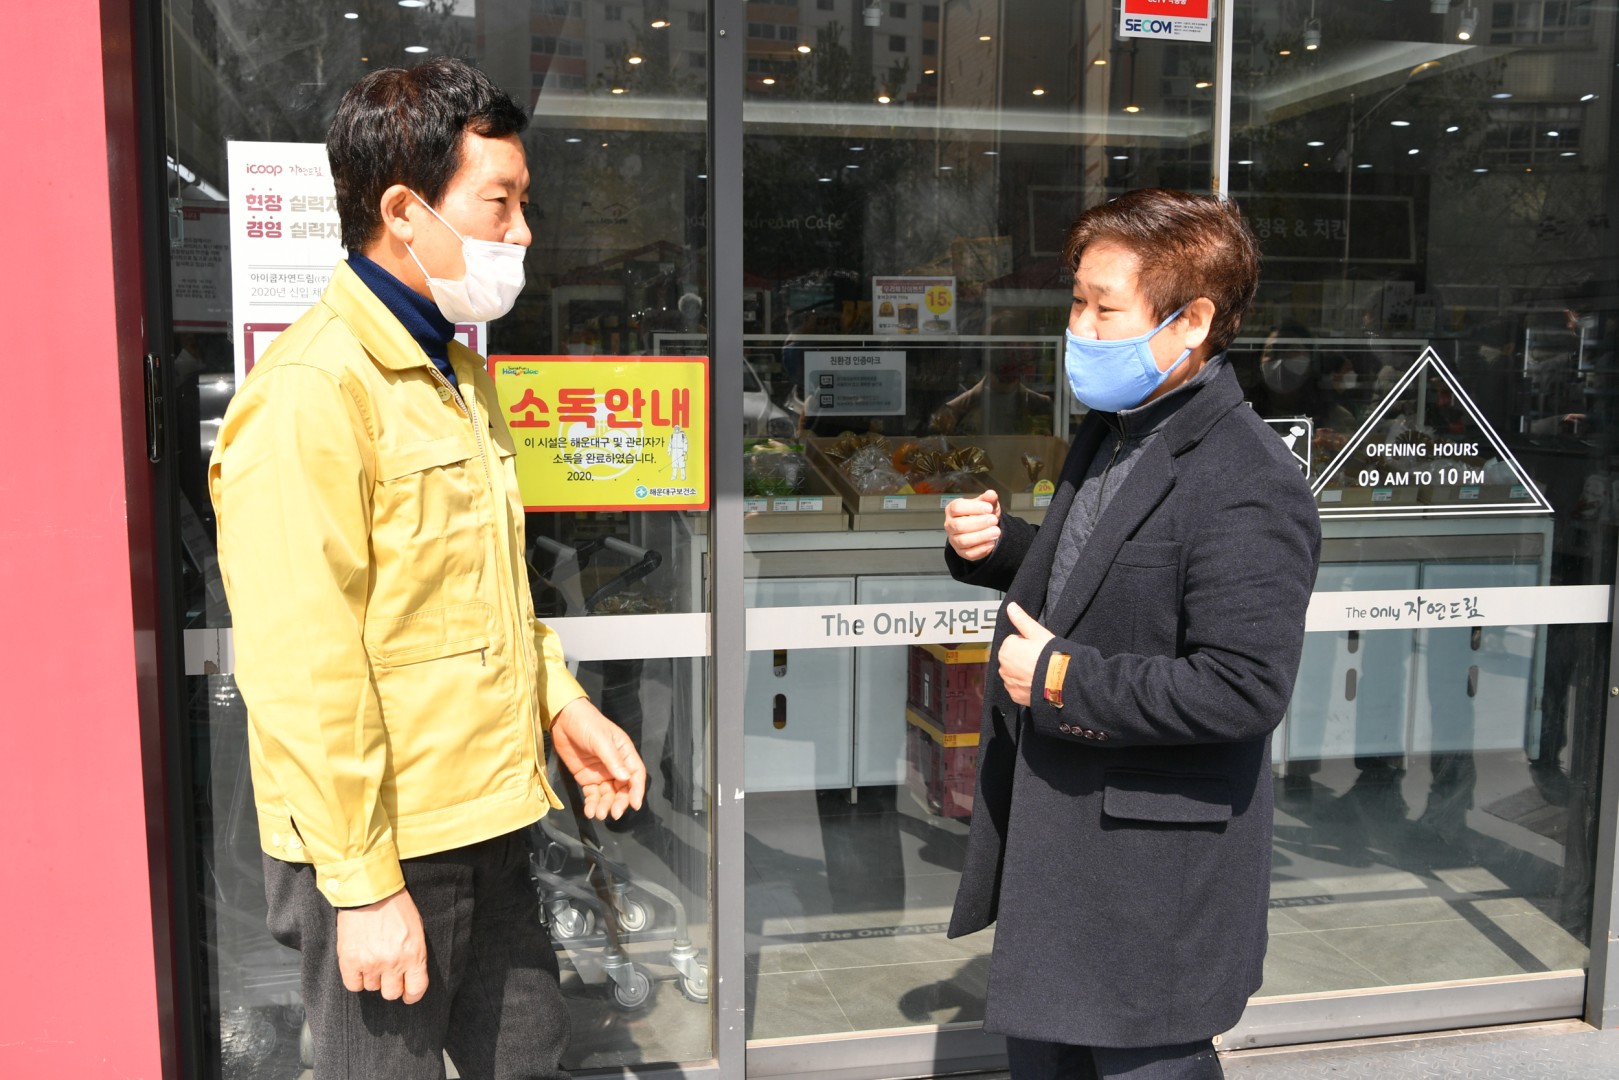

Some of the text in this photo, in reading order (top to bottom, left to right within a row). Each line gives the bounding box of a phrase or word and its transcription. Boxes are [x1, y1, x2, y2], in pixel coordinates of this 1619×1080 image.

[1125, 19, 1172, 34] SECOM
[289, 164, 324, 177] 자연드림
[246, 194, 282, 212] 현장
[246, 221, 282, 238] 경영
[1255, 217, 1348, 241] 정육 & 치킨
[251, 287, 327, 298] 2020년 신입 채
[830, 355, 882, 366] 친환경 인증마크
[509, 387, 690, 429] 소독안내
[524, 436, 665, 449] 이 시설은 해운대구 및 관리자가
[1366, 443, 1479, 457] OPENING HOURS
[552, 453, 657, 464] 소독을 완료하였습니다.
[1358, 468, 1485, 487] 09 AM TO 10 PM
[649, 487, 697, 497] 해운대구보건소
[1345, 596, 1485, 622] The Only 자연드림
[821, 607, 998, 638] The Only 자연드
